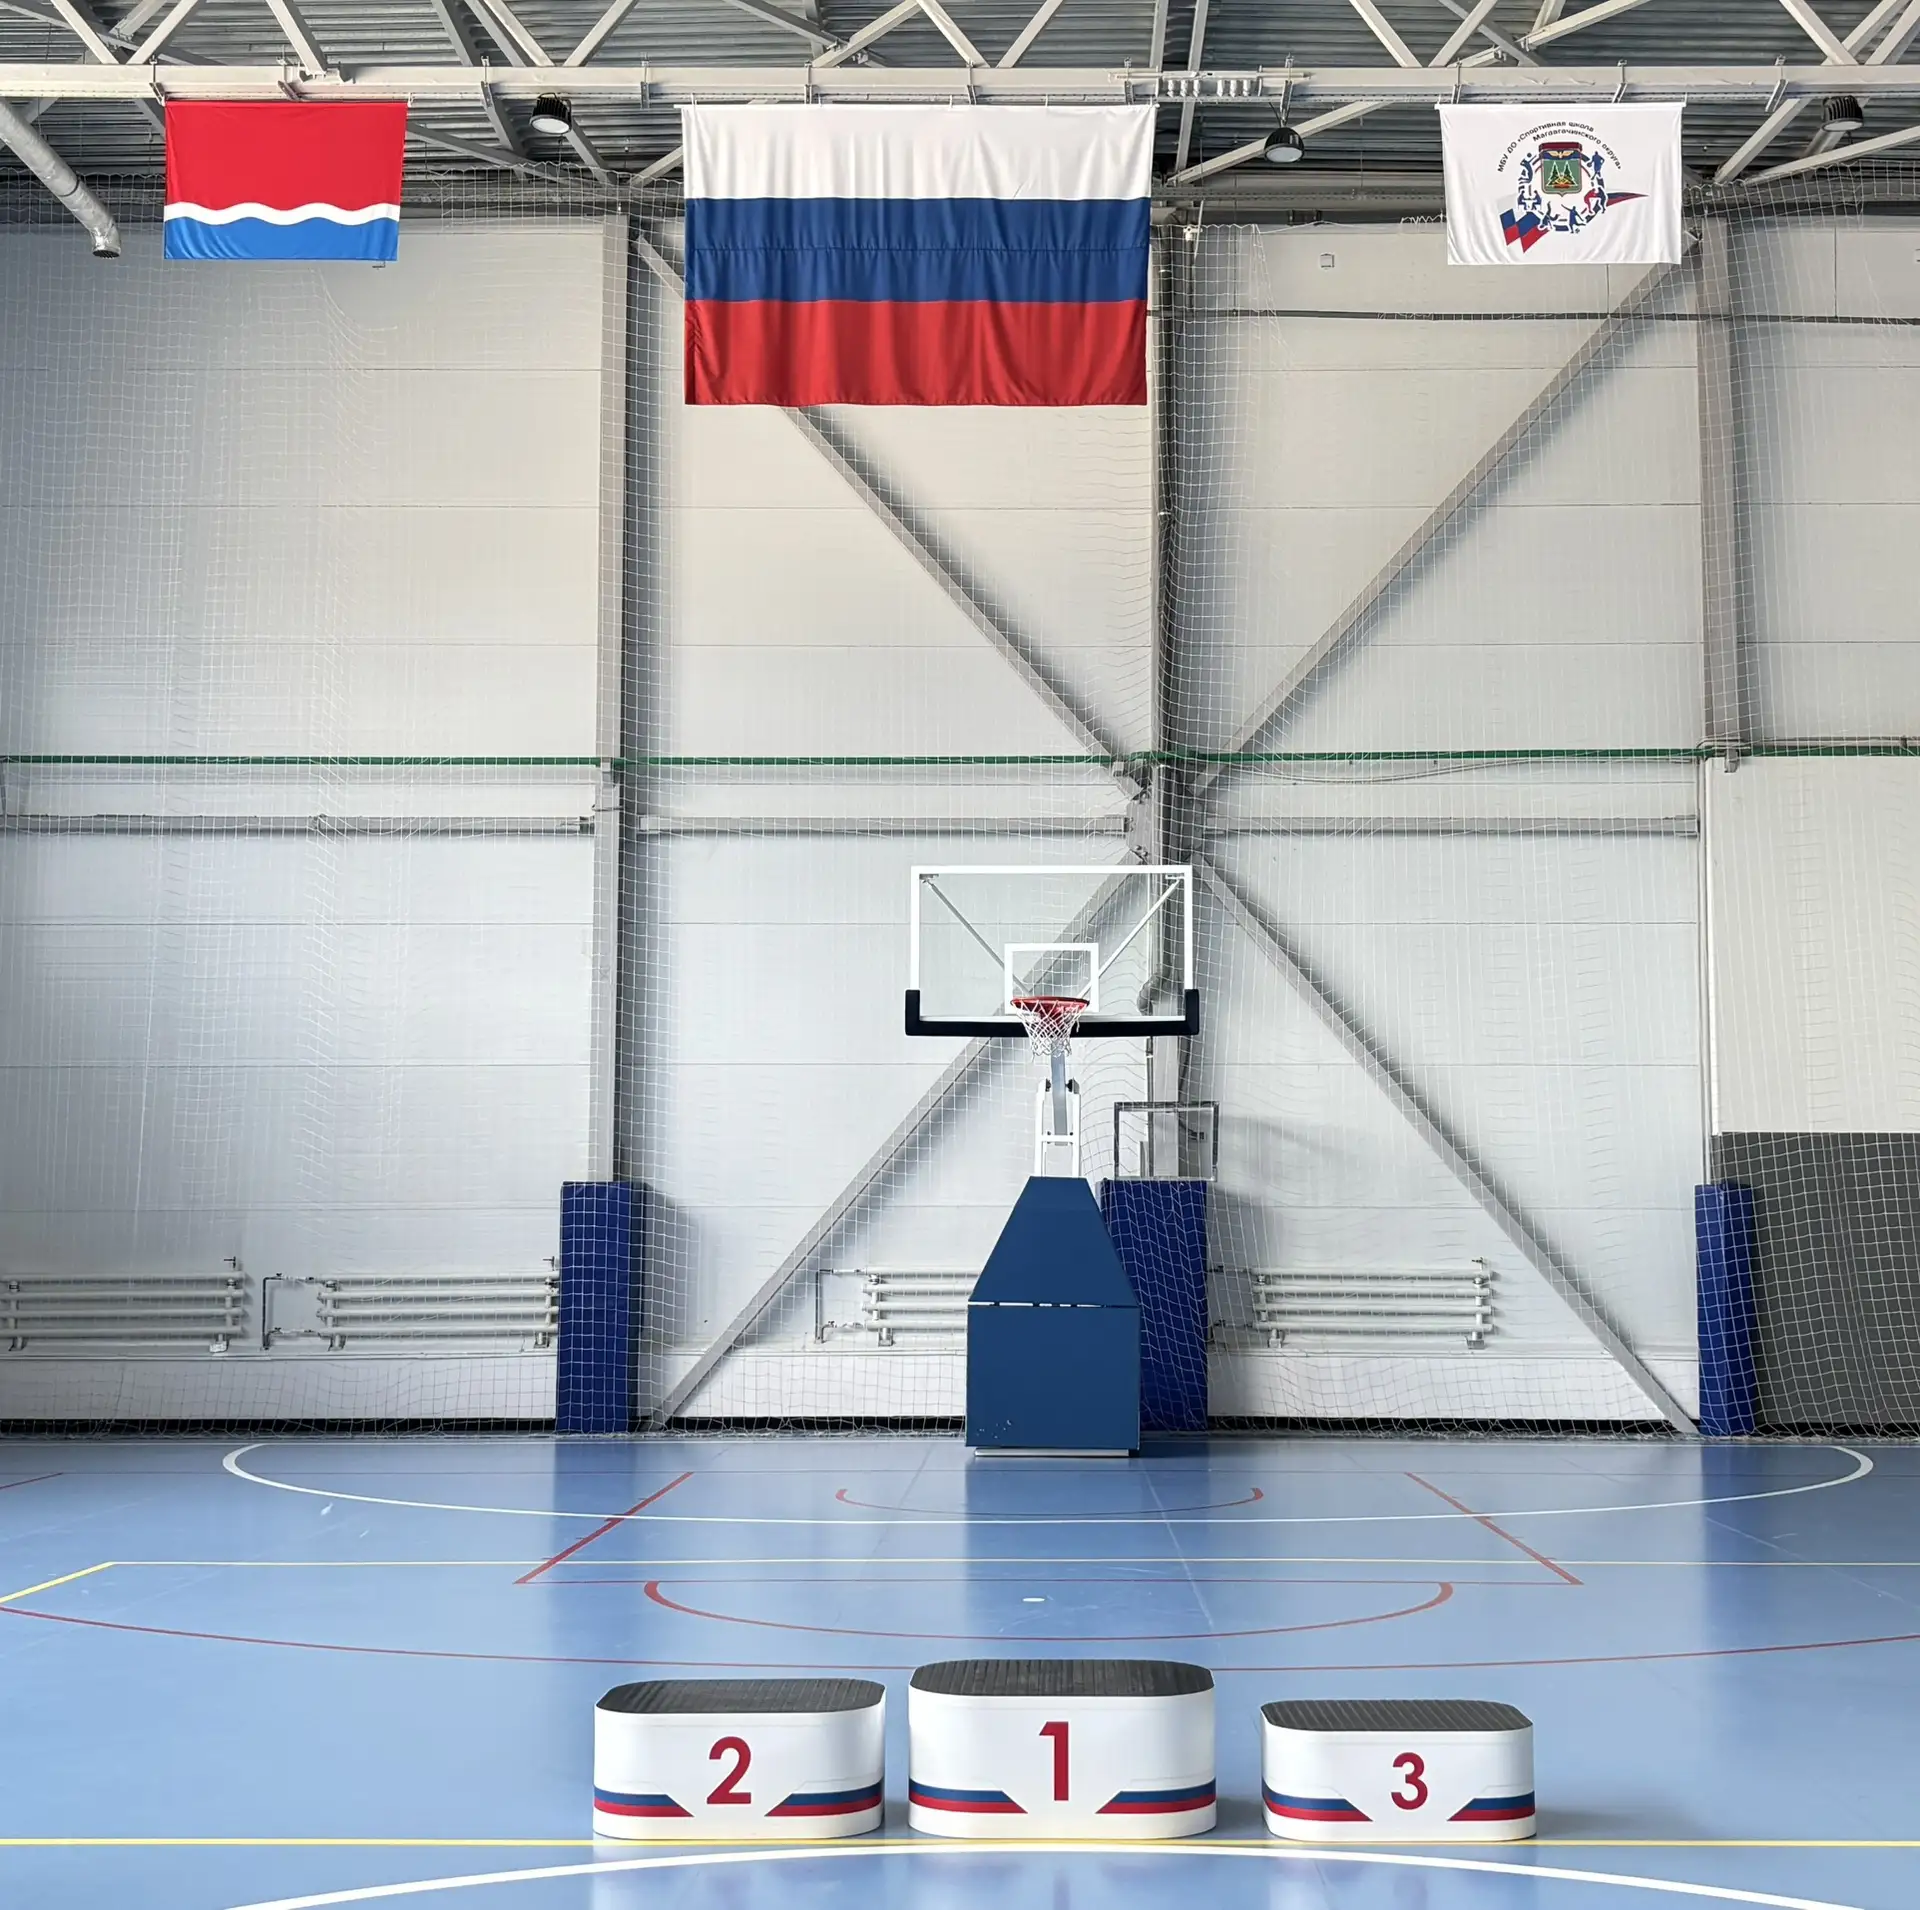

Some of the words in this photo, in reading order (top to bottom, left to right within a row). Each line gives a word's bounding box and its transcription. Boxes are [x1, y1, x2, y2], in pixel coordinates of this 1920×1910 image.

[1497, 154, 1509, 172] МБУ
[1507, 141, 1517, 154] ДО
[1568, 121, 1594, 132] школа
[708, 1737, 751, 1804] 2
[1039, 1721, 1069, 1801] 1
[1393, 1752, 1428, 1810] 3
